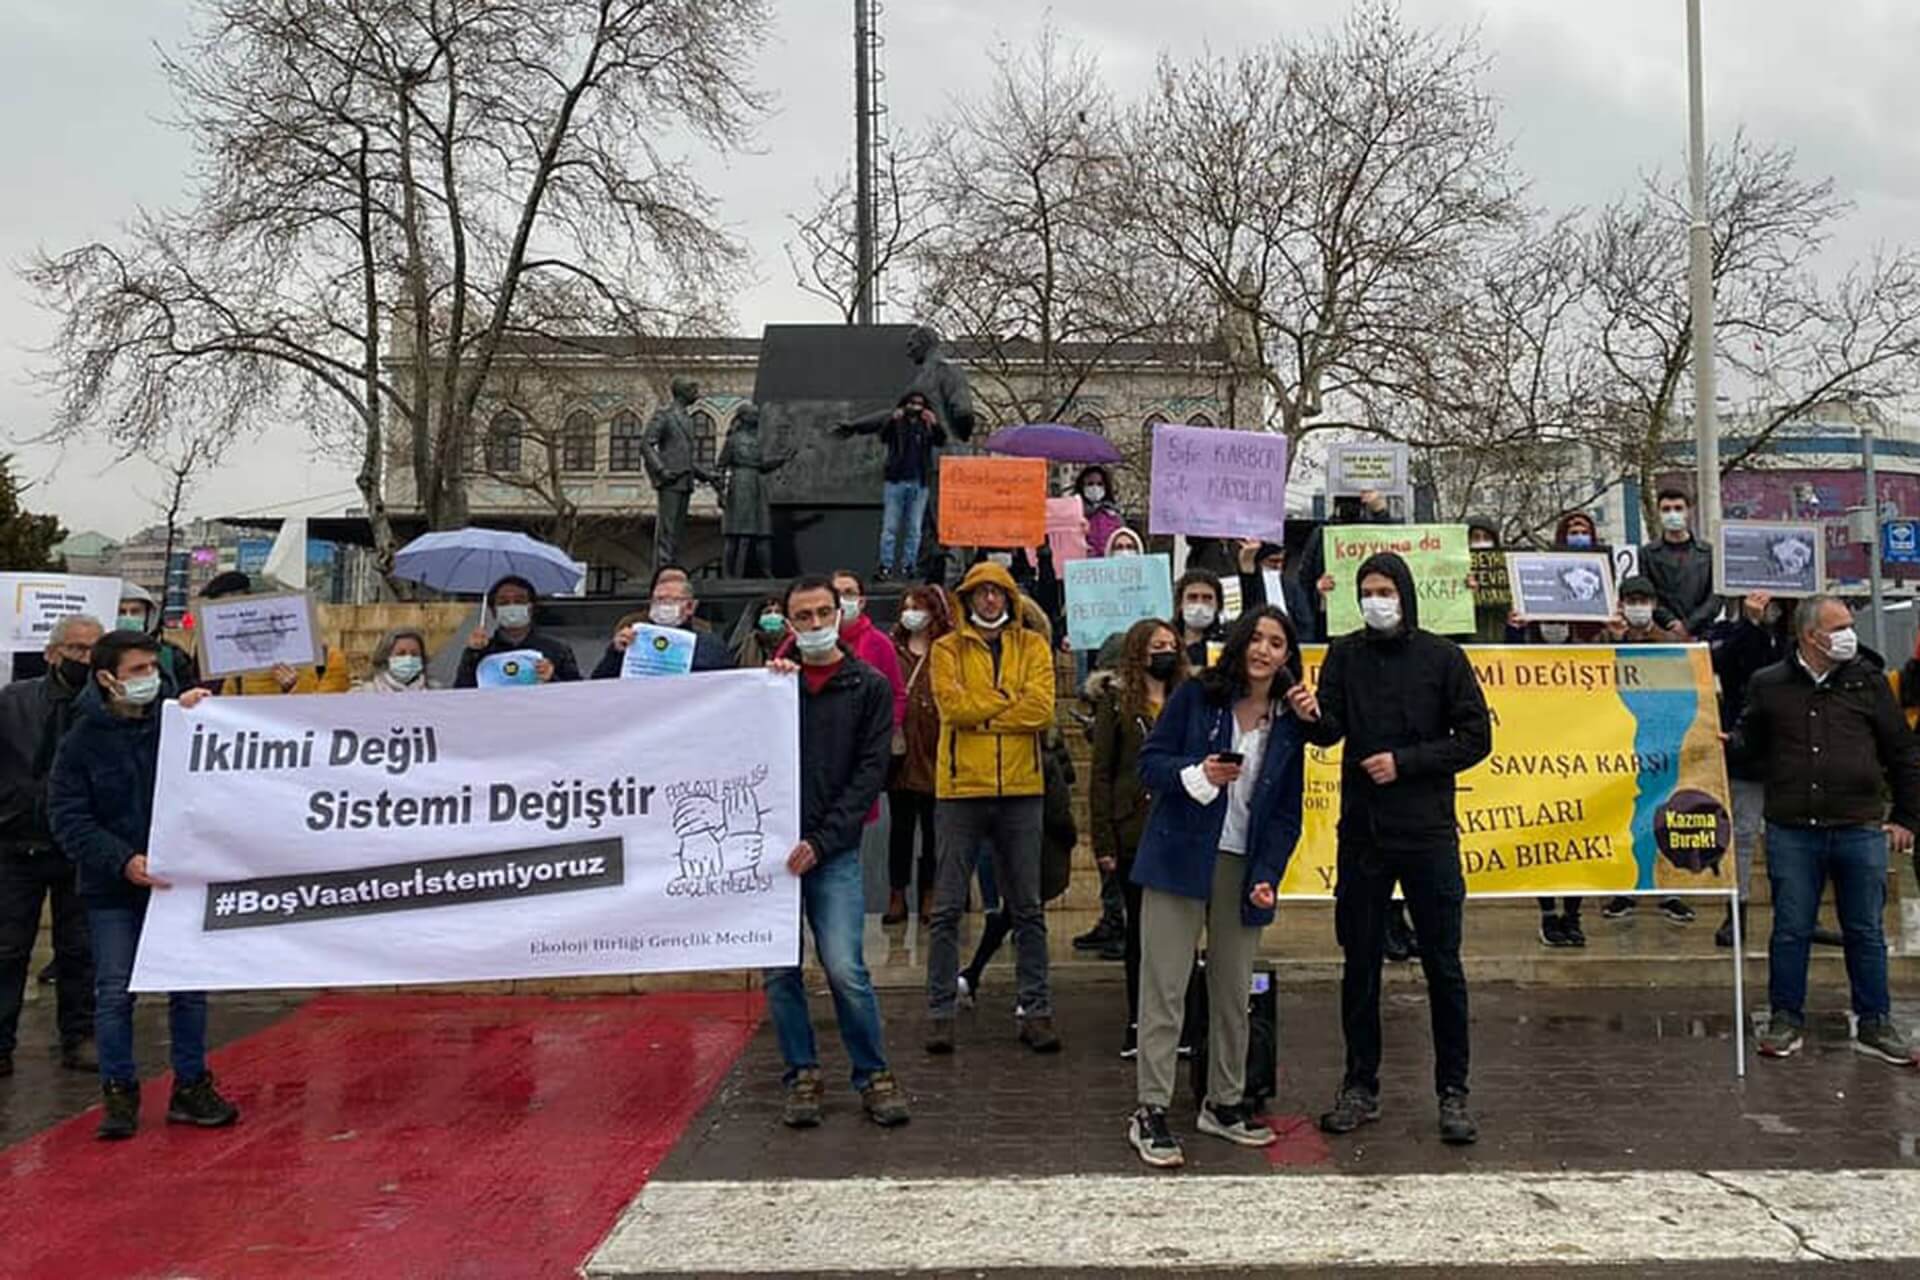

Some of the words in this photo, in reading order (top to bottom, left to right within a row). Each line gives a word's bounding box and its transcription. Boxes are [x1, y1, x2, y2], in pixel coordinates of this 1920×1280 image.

[1419, 531, 1441, 550] da
[1514, 658, 1641, 691] DEĞİŞTİR
[189, 723, 315, 772] İklimi
[328, 726, 438, 775] Değil
[1490, 753, 1588, 778] SAVAŞA
[306, 785, 473, 831] Sistemi
[488, 776, 656, 830] Değiştir
[1665, 810, 1717, 829] Kazma
[1669, 830, 1716, 848] Bırak!
[1464, 847, 1506, 875] DA
[1515, 834, 1613, 868] BIRAK!
[214, 855, 606, 916] #BoşVaatlerİstemiyoruz
[530, 939, 588, 955] Ekoloji
[593, 935, 644, 952] Birliği
[649, 931, 711, 949] Gençlik
[714, 929, 773, 946] Meclisi
